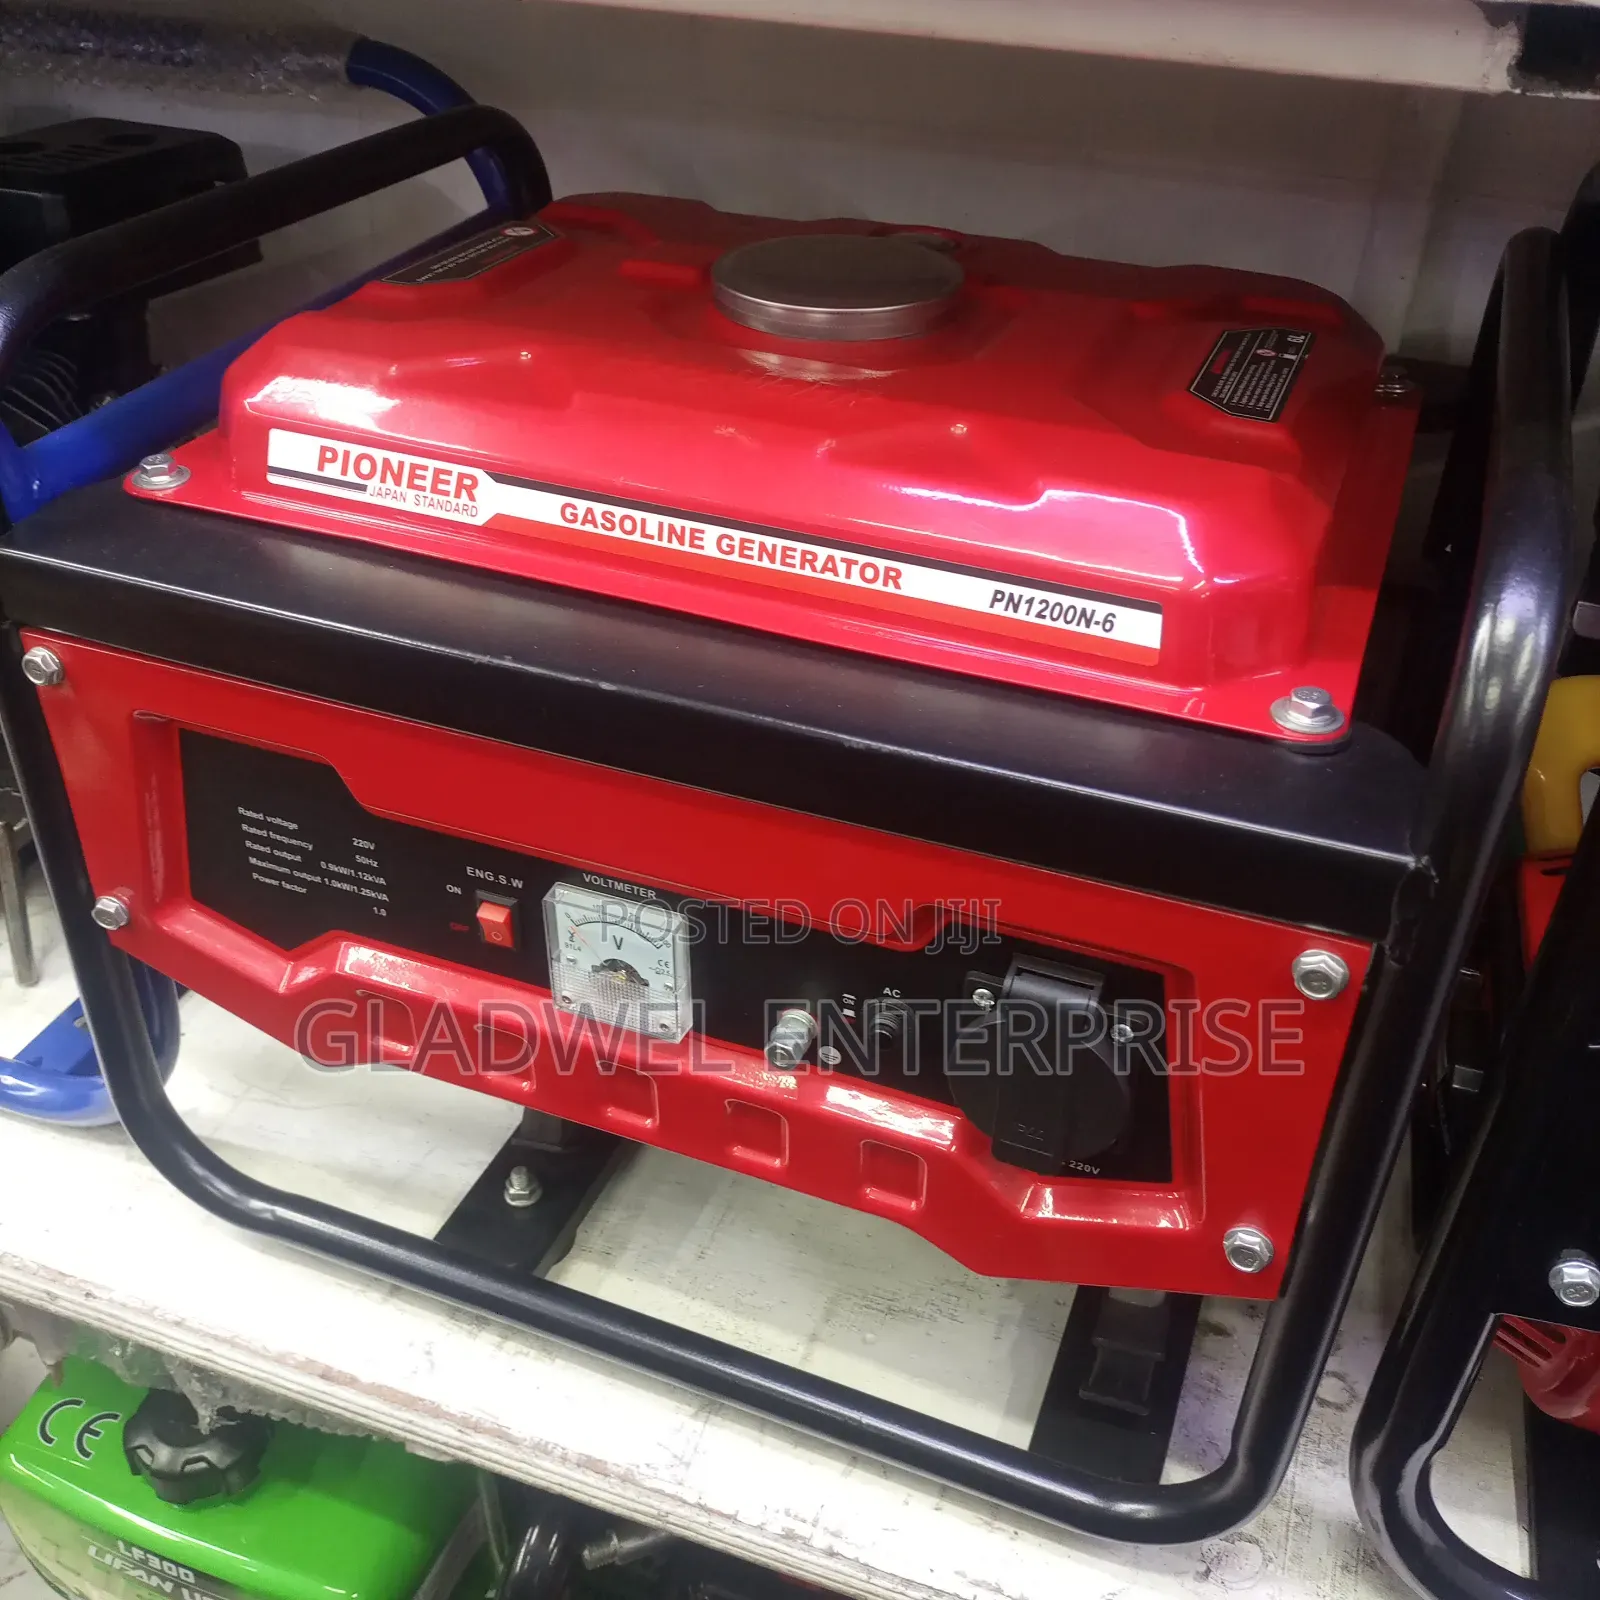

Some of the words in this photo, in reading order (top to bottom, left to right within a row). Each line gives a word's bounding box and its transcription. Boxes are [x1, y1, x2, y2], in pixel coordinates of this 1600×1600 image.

[317, 444, 479, 503] PIONEER
[369, 484, 408, 504] JAPAN
[413, 493, 479, 518] STANDARD
[560, 502, 706, 551] GASOLINE
[715, 533, 903, 590] GENERATOR
[989, 589, 1117, 633] PN1200N-6
[237, 806, 264, 821] Rated
[265, 815, 299, 830] voltage
[352, 837, 376, 851] 220V
[241, 823, 268, 837] Rated
[269, 831, 314, 851] frequency
[354, 854, 379, 868] 50Hz
[245, 840, 271, 854] Rated
[272, 848, 302, 863] output
[248, 856, 292, 875] Maximum
[293, 868, 322, 884] output
[252, 872, 280, 887] Power
[281, 880, 308, 894] factor
[466, 866, 524, 889] ENG.S.W
[445, 884, 462, 895] ON
[582, 872, 658, 900] VOLTMETER
[613, 935, 624, 951] V
[883, 987, 901, 998] AC
[1068, 1160, 1101, 1175] 220V
[37, 1397, 121, 1461] CE
[117, 1539, 196, 1584] LF300
